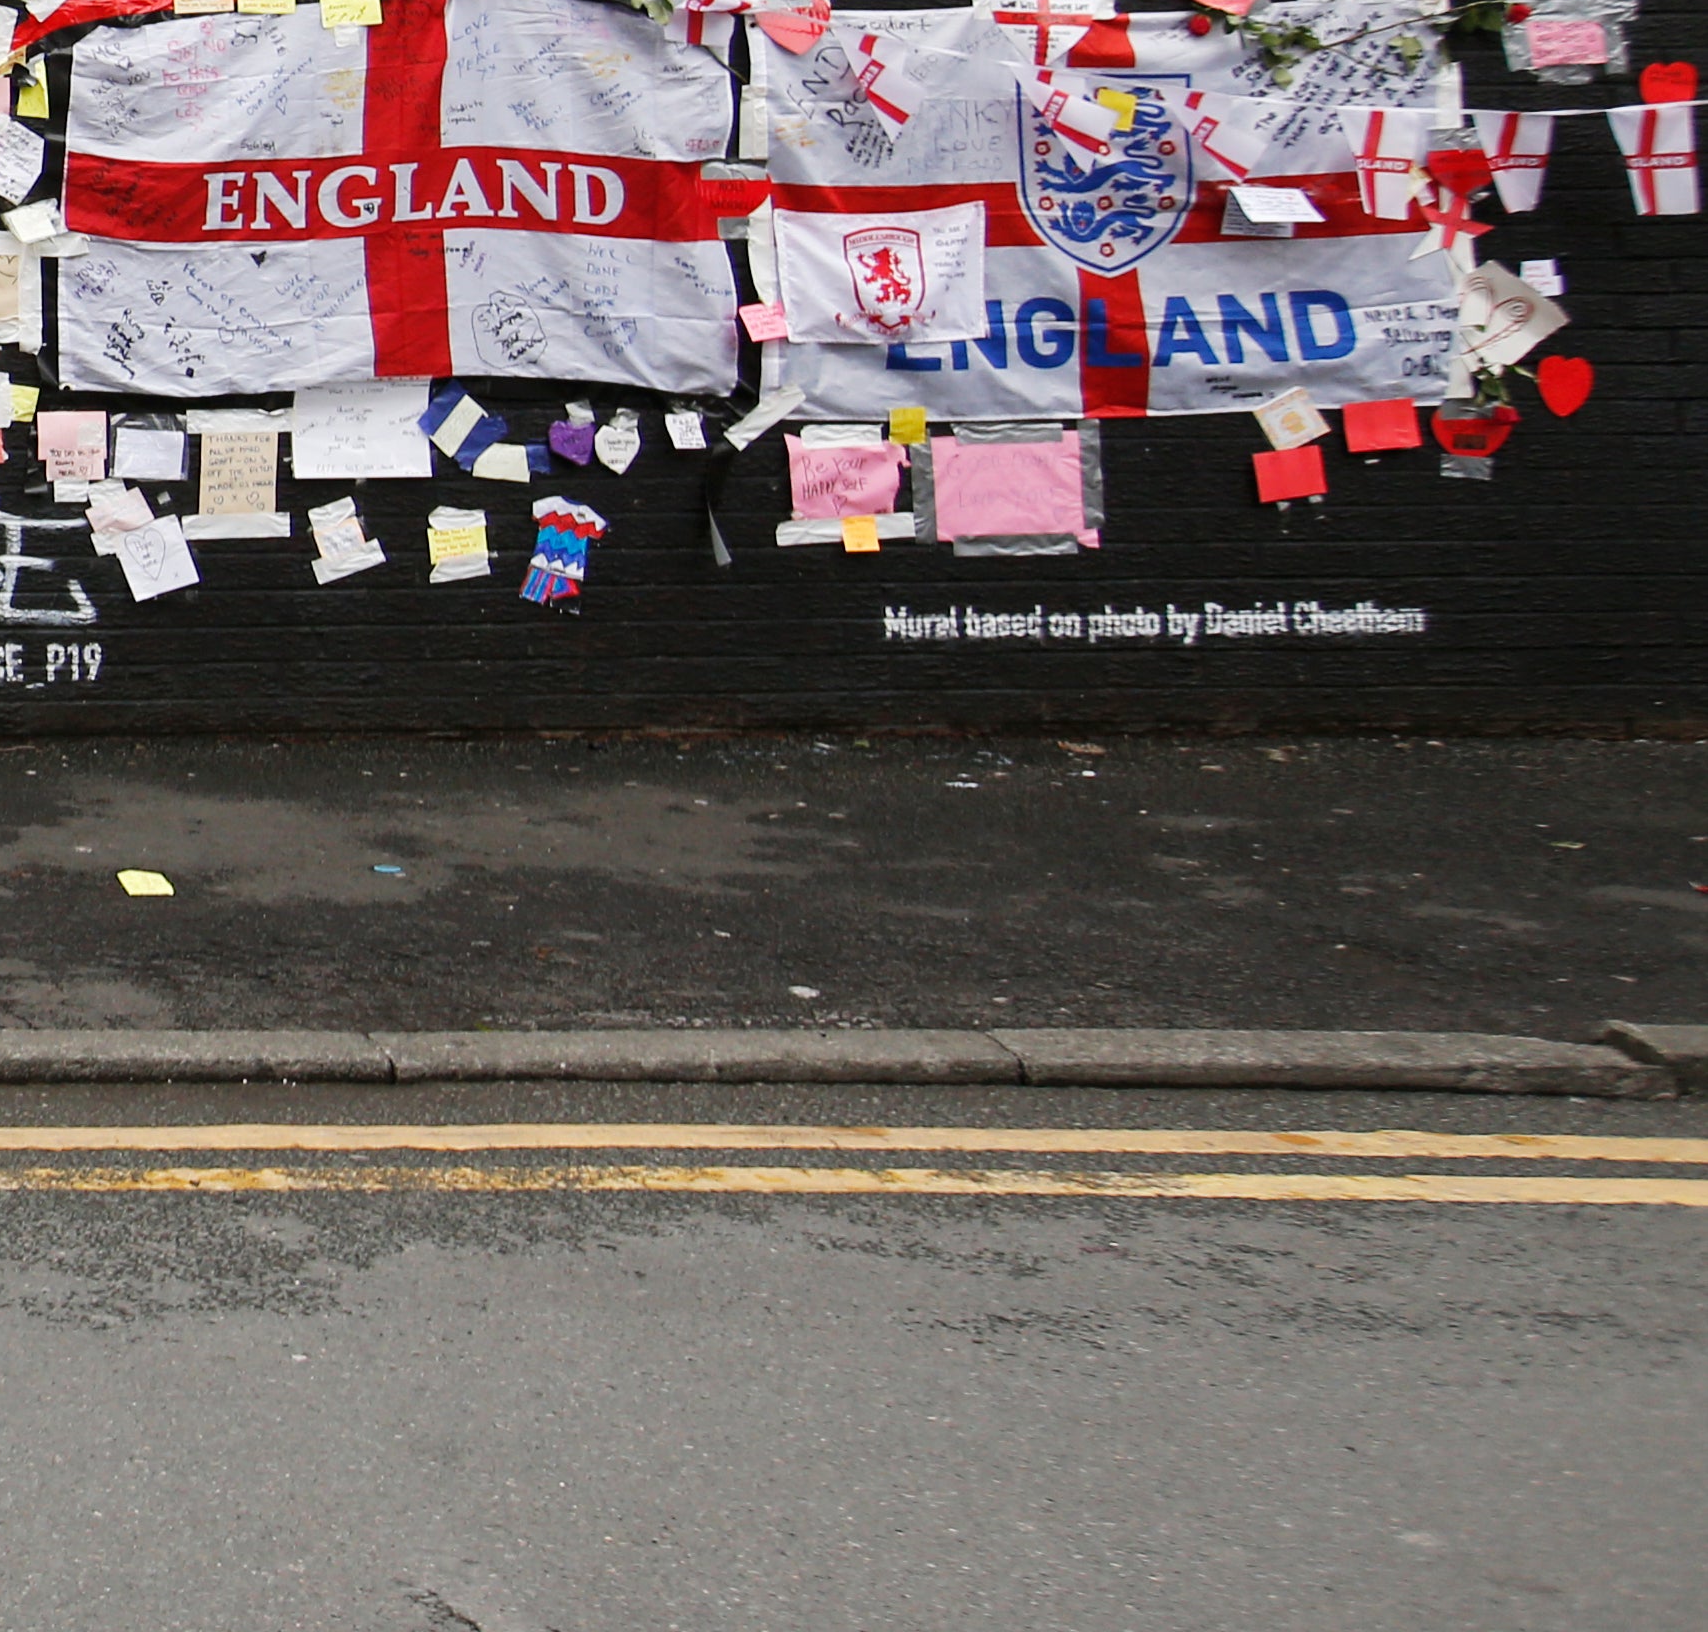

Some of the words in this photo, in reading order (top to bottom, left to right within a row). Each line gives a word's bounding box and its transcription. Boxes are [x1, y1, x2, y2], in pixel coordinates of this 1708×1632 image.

[200, 155, 626, 235] ENGLAND
[799, 454, 827, 476] Be
[800, 475, 838, 498] HAPPY
[883, 606, 958, 640] Mural
[964, 604, 1041, 640] based
[1046, 613, 1082, 639] on
[1087, 605, 1160, 645] photo
[1166, 604, 1200, 645] by
[1204, 601, 1287, 637] Daniel
